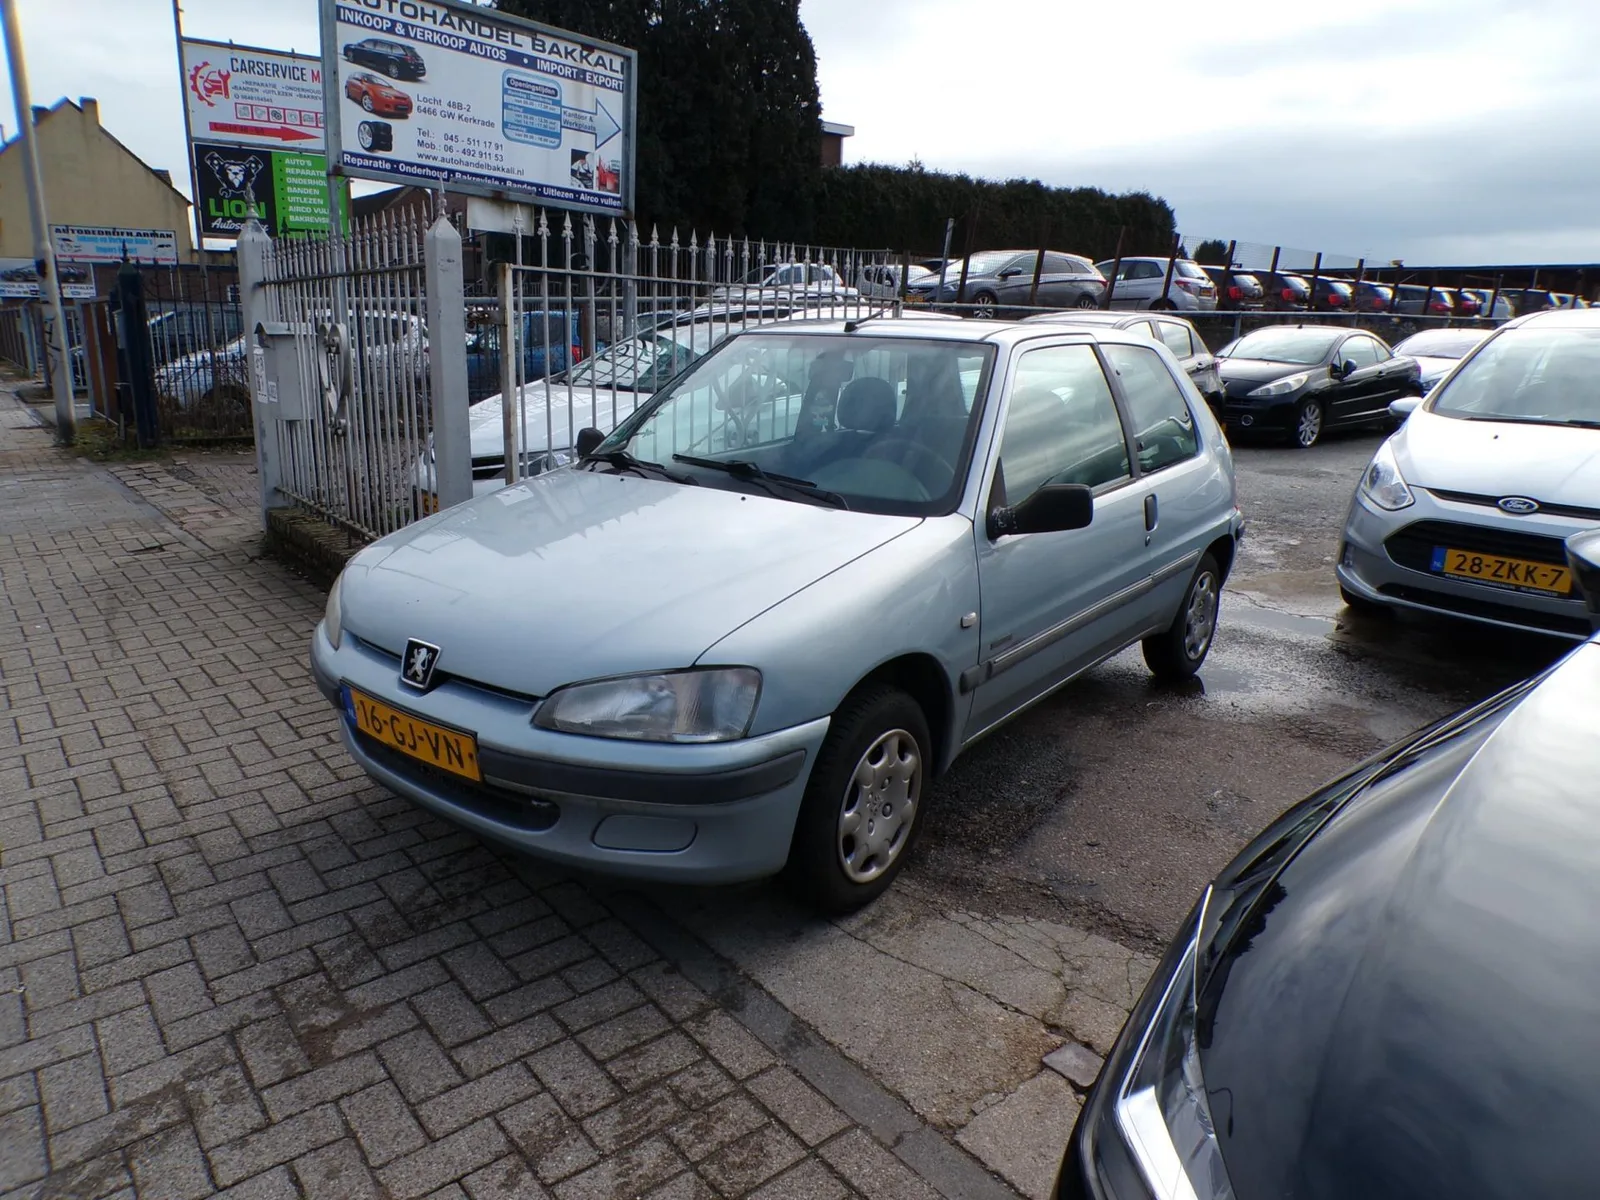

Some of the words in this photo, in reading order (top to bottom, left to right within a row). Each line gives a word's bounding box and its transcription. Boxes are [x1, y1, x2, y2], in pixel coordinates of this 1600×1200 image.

[340, 7, 391, 31] INKOOP
[394, 22, 405, 35] &
[408, 25, 467, 50] VERKOOP
[469, 42, 507, 61] AUTOS
[537, 58, 578, 79] IMPORT
[585, 71, 624, 91] EXPORT
[343, 0, 523, 47] UTOHANDEL
[531, 37, 624, 75] BAKKALI
[230, 57, 307, 82] CARSERVICE
[416, 94, 442, 106] Locht
[446, 100, 471, 112] 48B-2
[416, 105, 438, 117] 6466
[439, 110, 455, 119] GW
[457, 113, 495, 128] Kerkrade
[416, 127, 435, 139] Tel.:
[443, 133, 459, 143] 045
[466, 137, 481, 147] 511
[483, 141, 492, 149] 17
[494, 142, 504, 151] 91
[416, 152, 525, 176] www.autohandelbakkali.nl
[443, 144, 454, 153] 06
[461, 148, 476, 158] 492
[478, 151, 492, 160] 911
[494, 153, 504, 162] 53
[287, 186, 320, 195] BANDEN
[343, 153, 391, 170] Reparatie
[398, 162, 448, 179] Onderhoud
[542, 187, 574, 199] Uitlezen
[579, 192, 599, 203] Airco
[600, 196, 621, 206] vullen
[209, 198, 266, 219] LION
[1506, 499, 1529, 509] Ford
[1453, 553, 1564, 587] 28-ZKK-7
[358, 699, 465, 769] 16-GJ-VN
